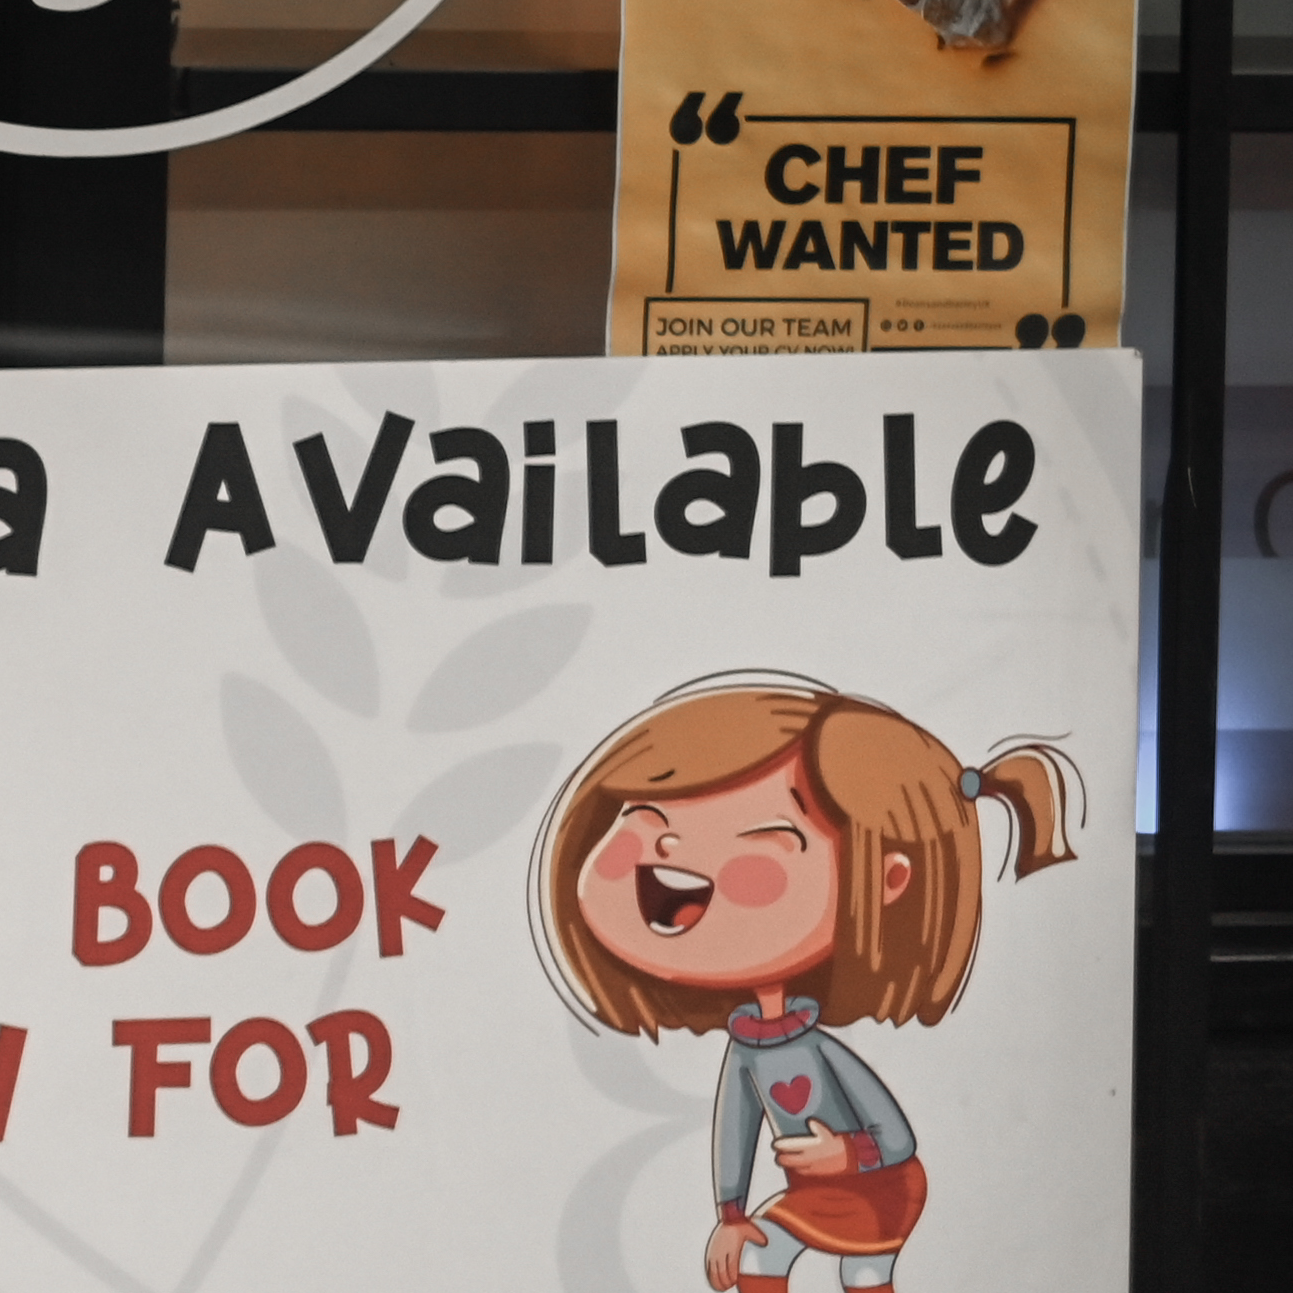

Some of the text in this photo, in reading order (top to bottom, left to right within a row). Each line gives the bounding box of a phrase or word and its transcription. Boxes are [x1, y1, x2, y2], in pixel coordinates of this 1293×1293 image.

[764, 142, 984, 206] CHEF
[716, 219, 1026, 272] WANTED
[656, 317, 852, 337] JOIN OUR TEAM
[71, 833, 446, 968] BOOK
[111, 1008, 401, 1139] FOR
